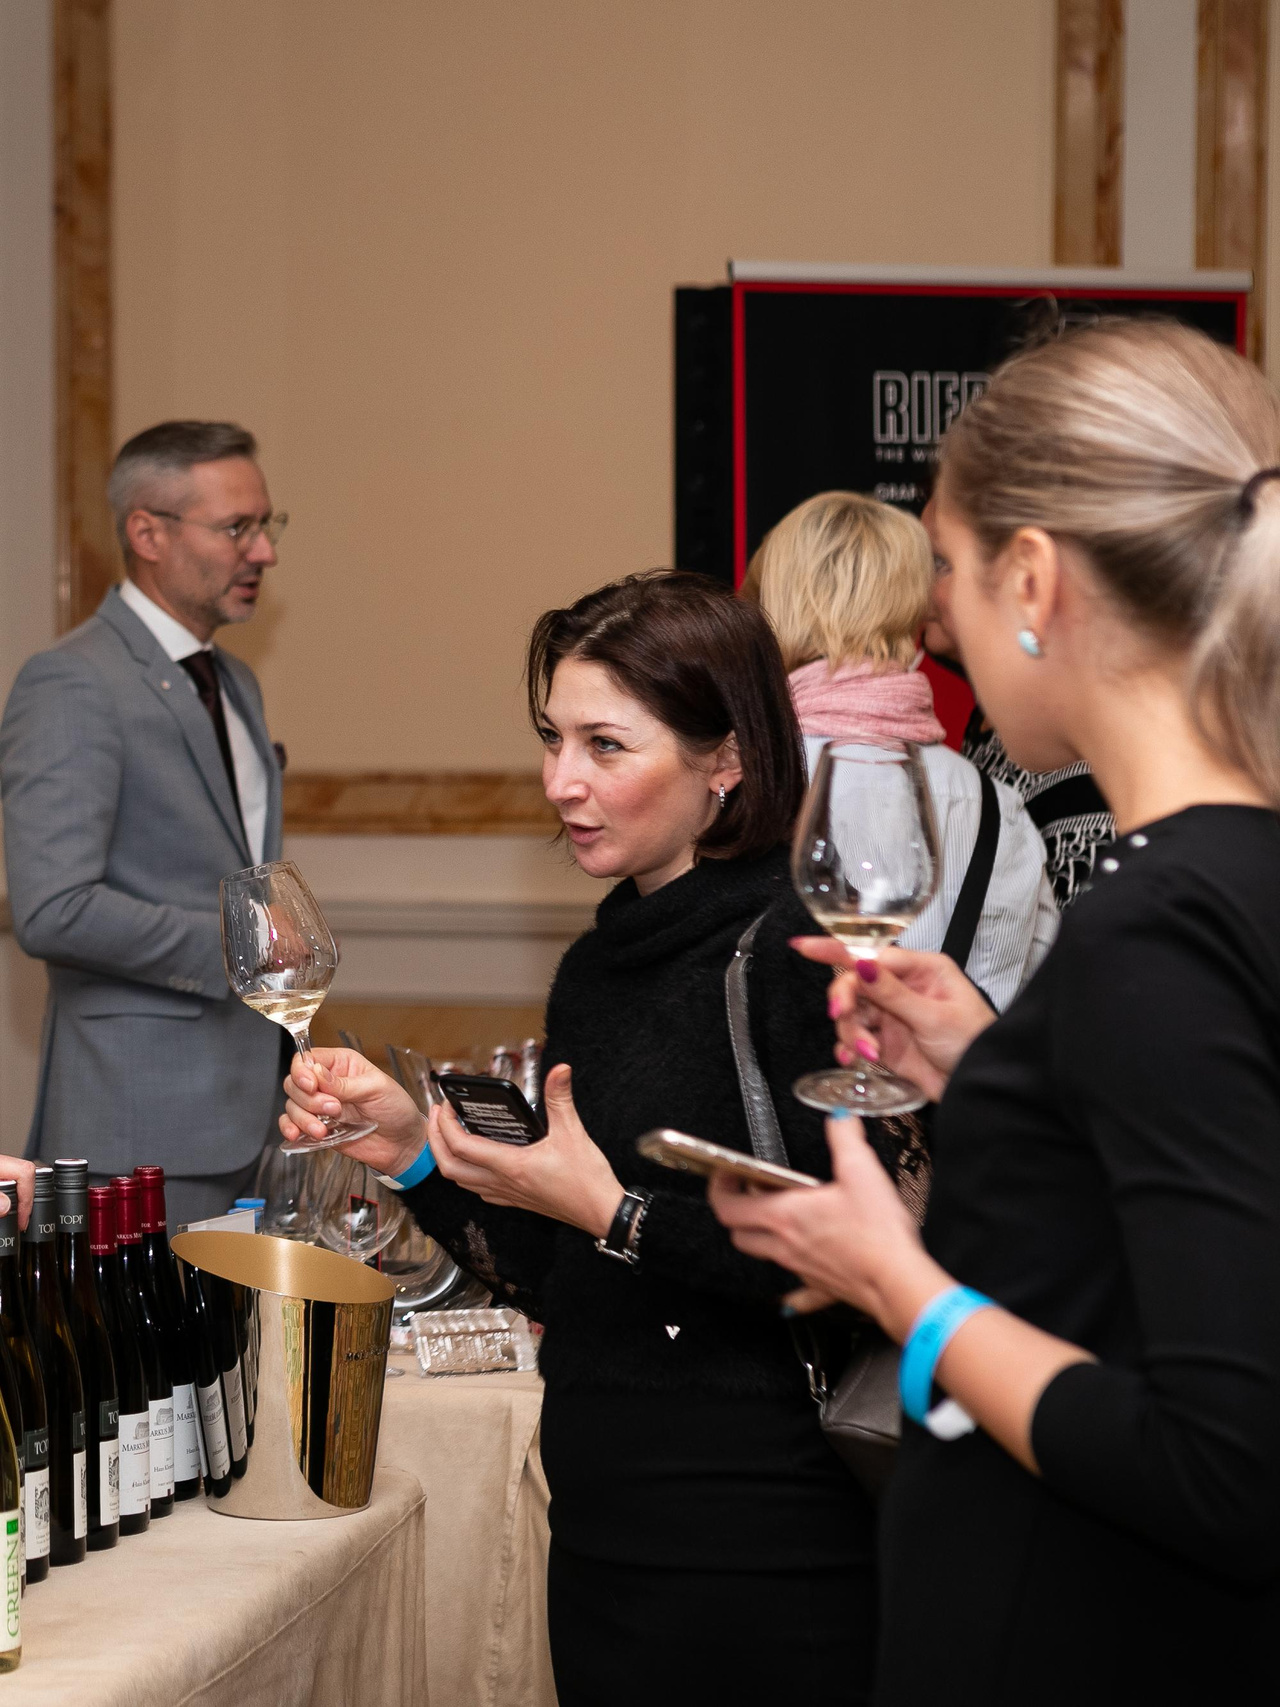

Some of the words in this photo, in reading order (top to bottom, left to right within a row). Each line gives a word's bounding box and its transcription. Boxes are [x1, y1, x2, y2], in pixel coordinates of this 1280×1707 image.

[59, 1214, 83, 1225] TOPF
[108, 1410, 119, 1424] TO
[7, 1538, 19, 1638] GREEN
